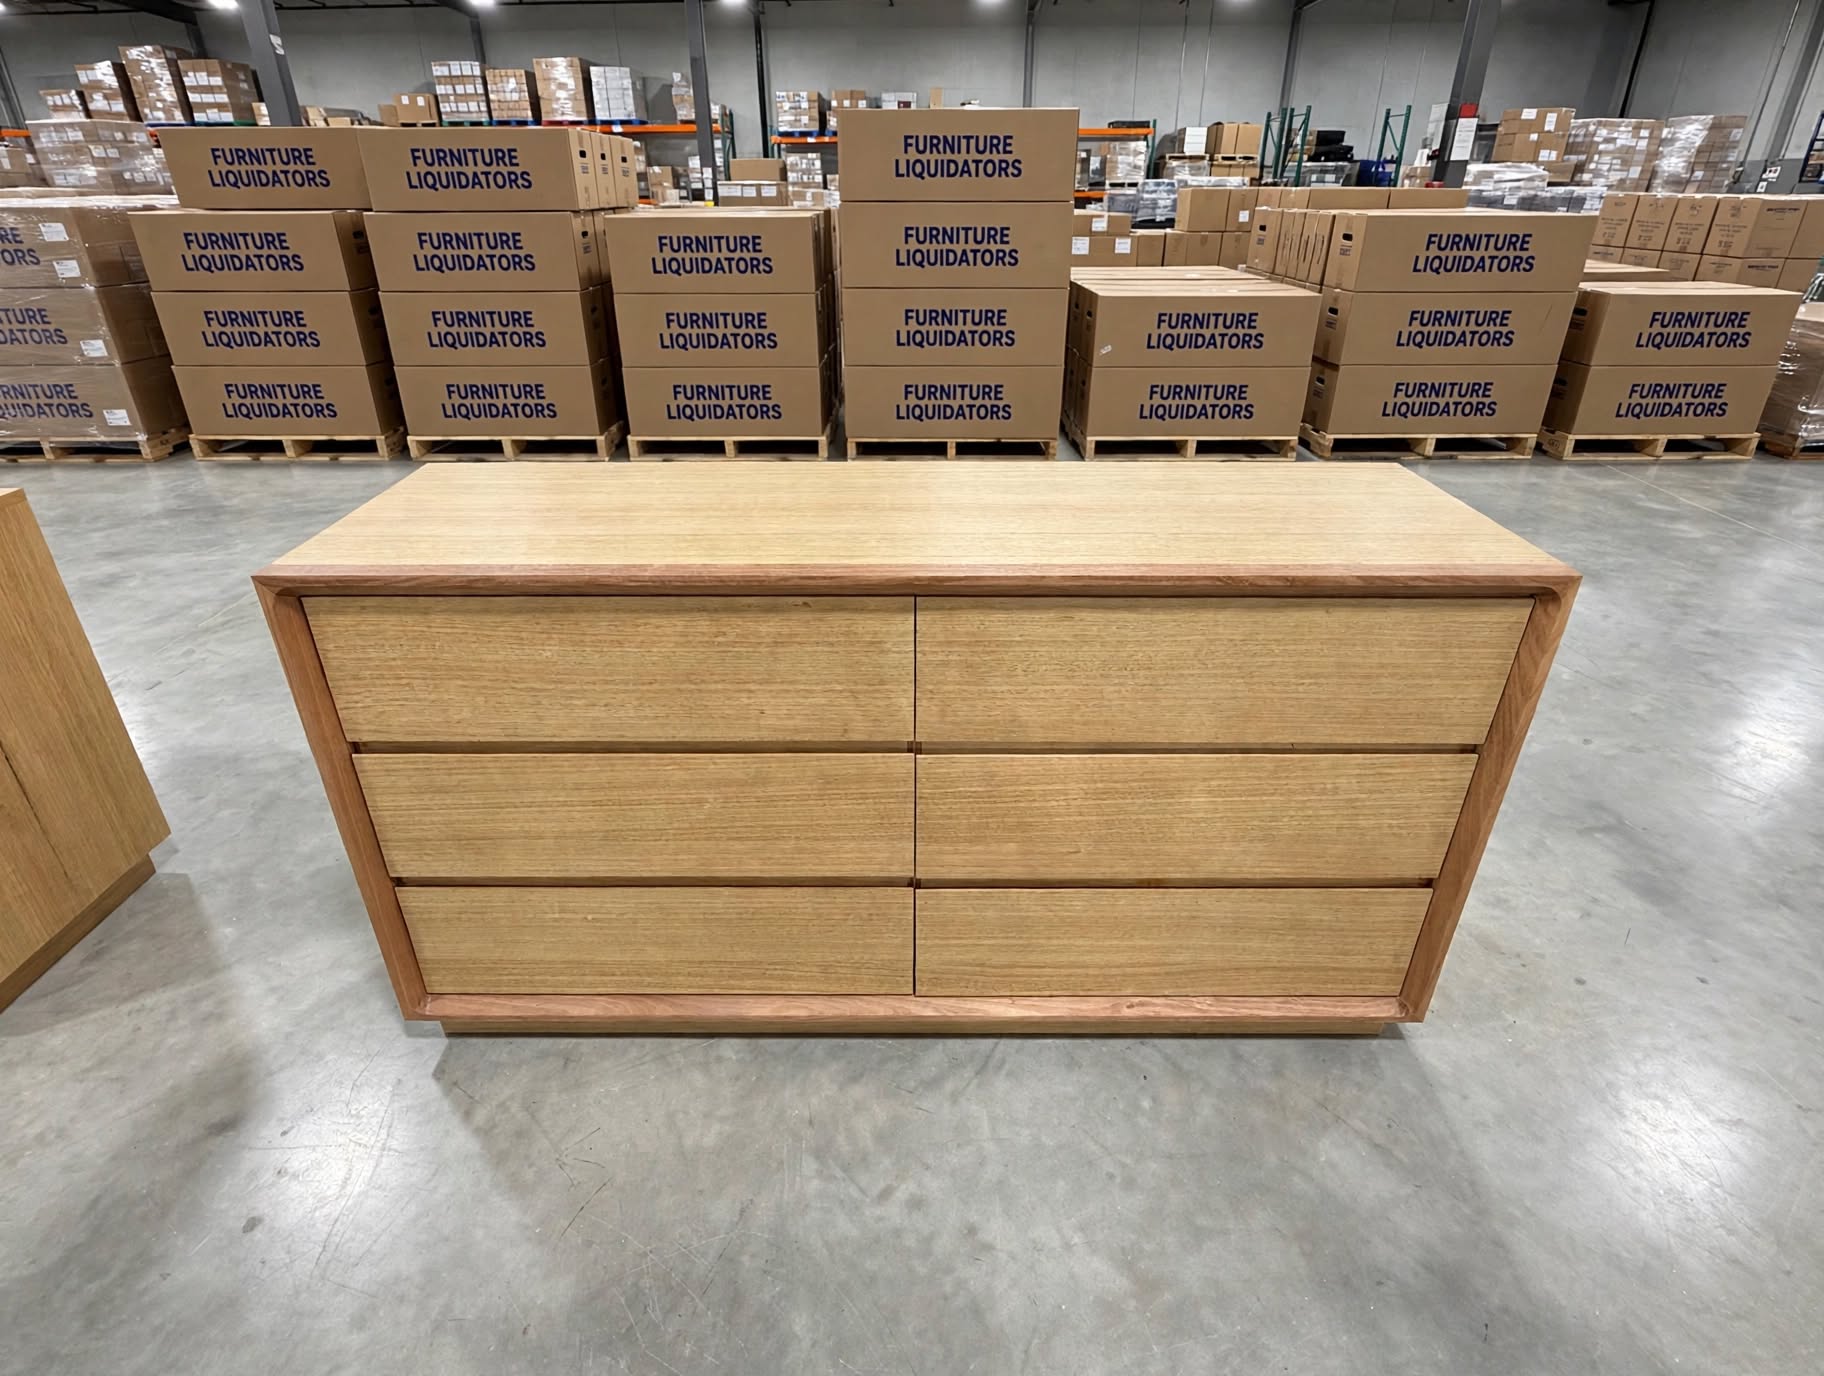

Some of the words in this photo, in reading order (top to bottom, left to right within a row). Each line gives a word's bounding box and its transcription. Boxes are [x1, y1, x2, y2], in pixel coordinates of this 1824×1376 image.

[903, 134, 1014, 155] FURNITURE
[210, 146, 316, 167] FURNITURE
[409, 147, 520, 168] FURNITURE
[895, 159, 1022, 179] LIQUIDATORS
[208, 169, 331, 189] LIQUIDATORS
[406, 170, 532, 191] LIQUIDATORS
[183, 231, 290, 251] FURNITURE
[416, 231, 524, 251] FURNITURE
[657, 234, 763, 254] FURNITURE
[903, 225, 1011, 246] FURNITURE
[1425, 232, 1533, 253] FURNITURE
[182, 253, 304, 272] LIQUIDATORS
[414, 253, 535, 272] LIQUIDATORS
[652, 256, 772, 276] LIQUIDATORS
[896, 248, 1018, 268] LIQUIDATORS
[1413, 255, 1535, 274] LIQUIDATORS
[203, 309, 307, 328] FURNITURE
[431, 309, 534, 329] FURNITURE
[665, 311, 768, 331] FURNITURE
[903, 307, 1008, 327] FURNITURE
[1156, 312, 1259, 330] FURNITURE
[1407, 309, 1512, 327] FURNITURE
[1649, 311, 1751, 329] FURNITURE
[202, 330, 320, 349] LIQUIDATORS
[428, 330, 546, 348] LIQUIDATORS
[659, 332, 777, 351] LIQUIDATORS
[896, 329, 1015, 348] LIQUIDATORS
[1146, 332, 1263, 351] LIQUIDATORS
[1396, 330, 1514, 348] LIQUIDATORS
[1636, 332, 1751, 349] LIQUIDATORS
[0, 383, 78, 400] RNITURE
[224, 383, 325, 401] FURNITURE
[445, 383, 546, 401] FURNITURE
[672, 383, 772, 401] FURNITURE
[903, 383, 1004, 401] FURNITURE
[1148, 383, 1249, 401] FURNITURE
[1393, 381, 1493, 400] FURNITURE
[1629, 382, 1727, 401] FURNITURE
[223, 402, 336, 419] LIQUIDATORS
[442, 402, 557, 419] LIQUIDATORS
[666, 403, 782, 420] LIQUIDATORS
[896, 403, 1011, 421] LIQUIDATORS
[1139, 402, 1253, 420] LIQUIDATORS
[1382, 400, 1496, 418] LIQUIDATORS
[1616, 401, 1728, 419] LIQUIDATORS
